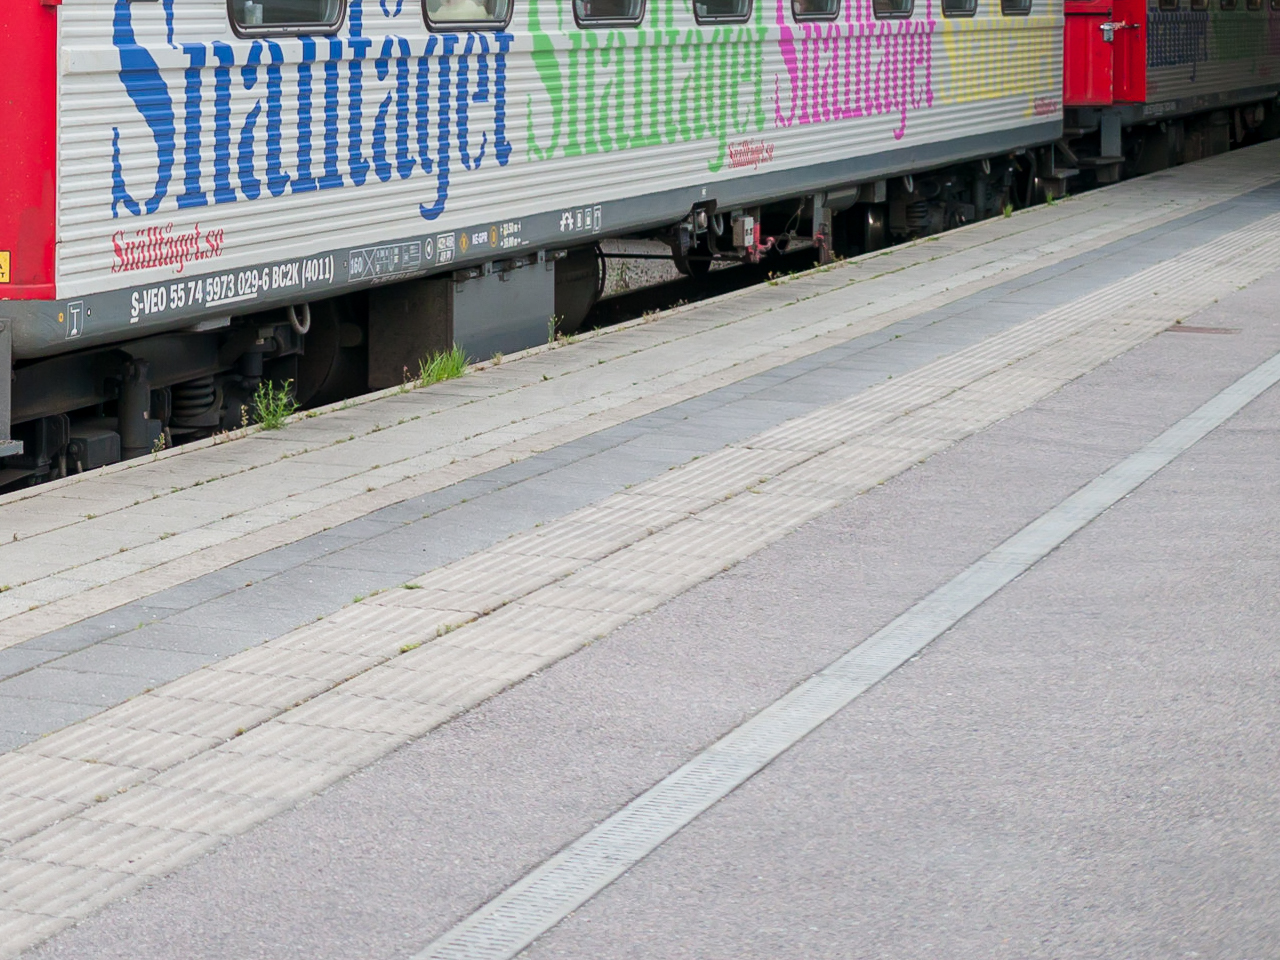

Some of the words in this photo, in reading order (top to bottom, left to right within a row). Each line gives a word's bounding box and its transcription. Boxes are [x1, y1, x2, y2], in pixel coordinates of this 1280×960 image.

[111, 222, 224, 274] Snälltåget.se
[350, 256, 363, 275] 160
[130, 287, 166, 321] S-VEO
[170, 283, 185, 309] 55
[188, 280, 203, 305] 74
[206, 273, 235, 302] 5973
[238, 268, 269, 294] 029-6
[272, 261, 299, 289] BC2K
[302, 255, 334, 288] (4011)
